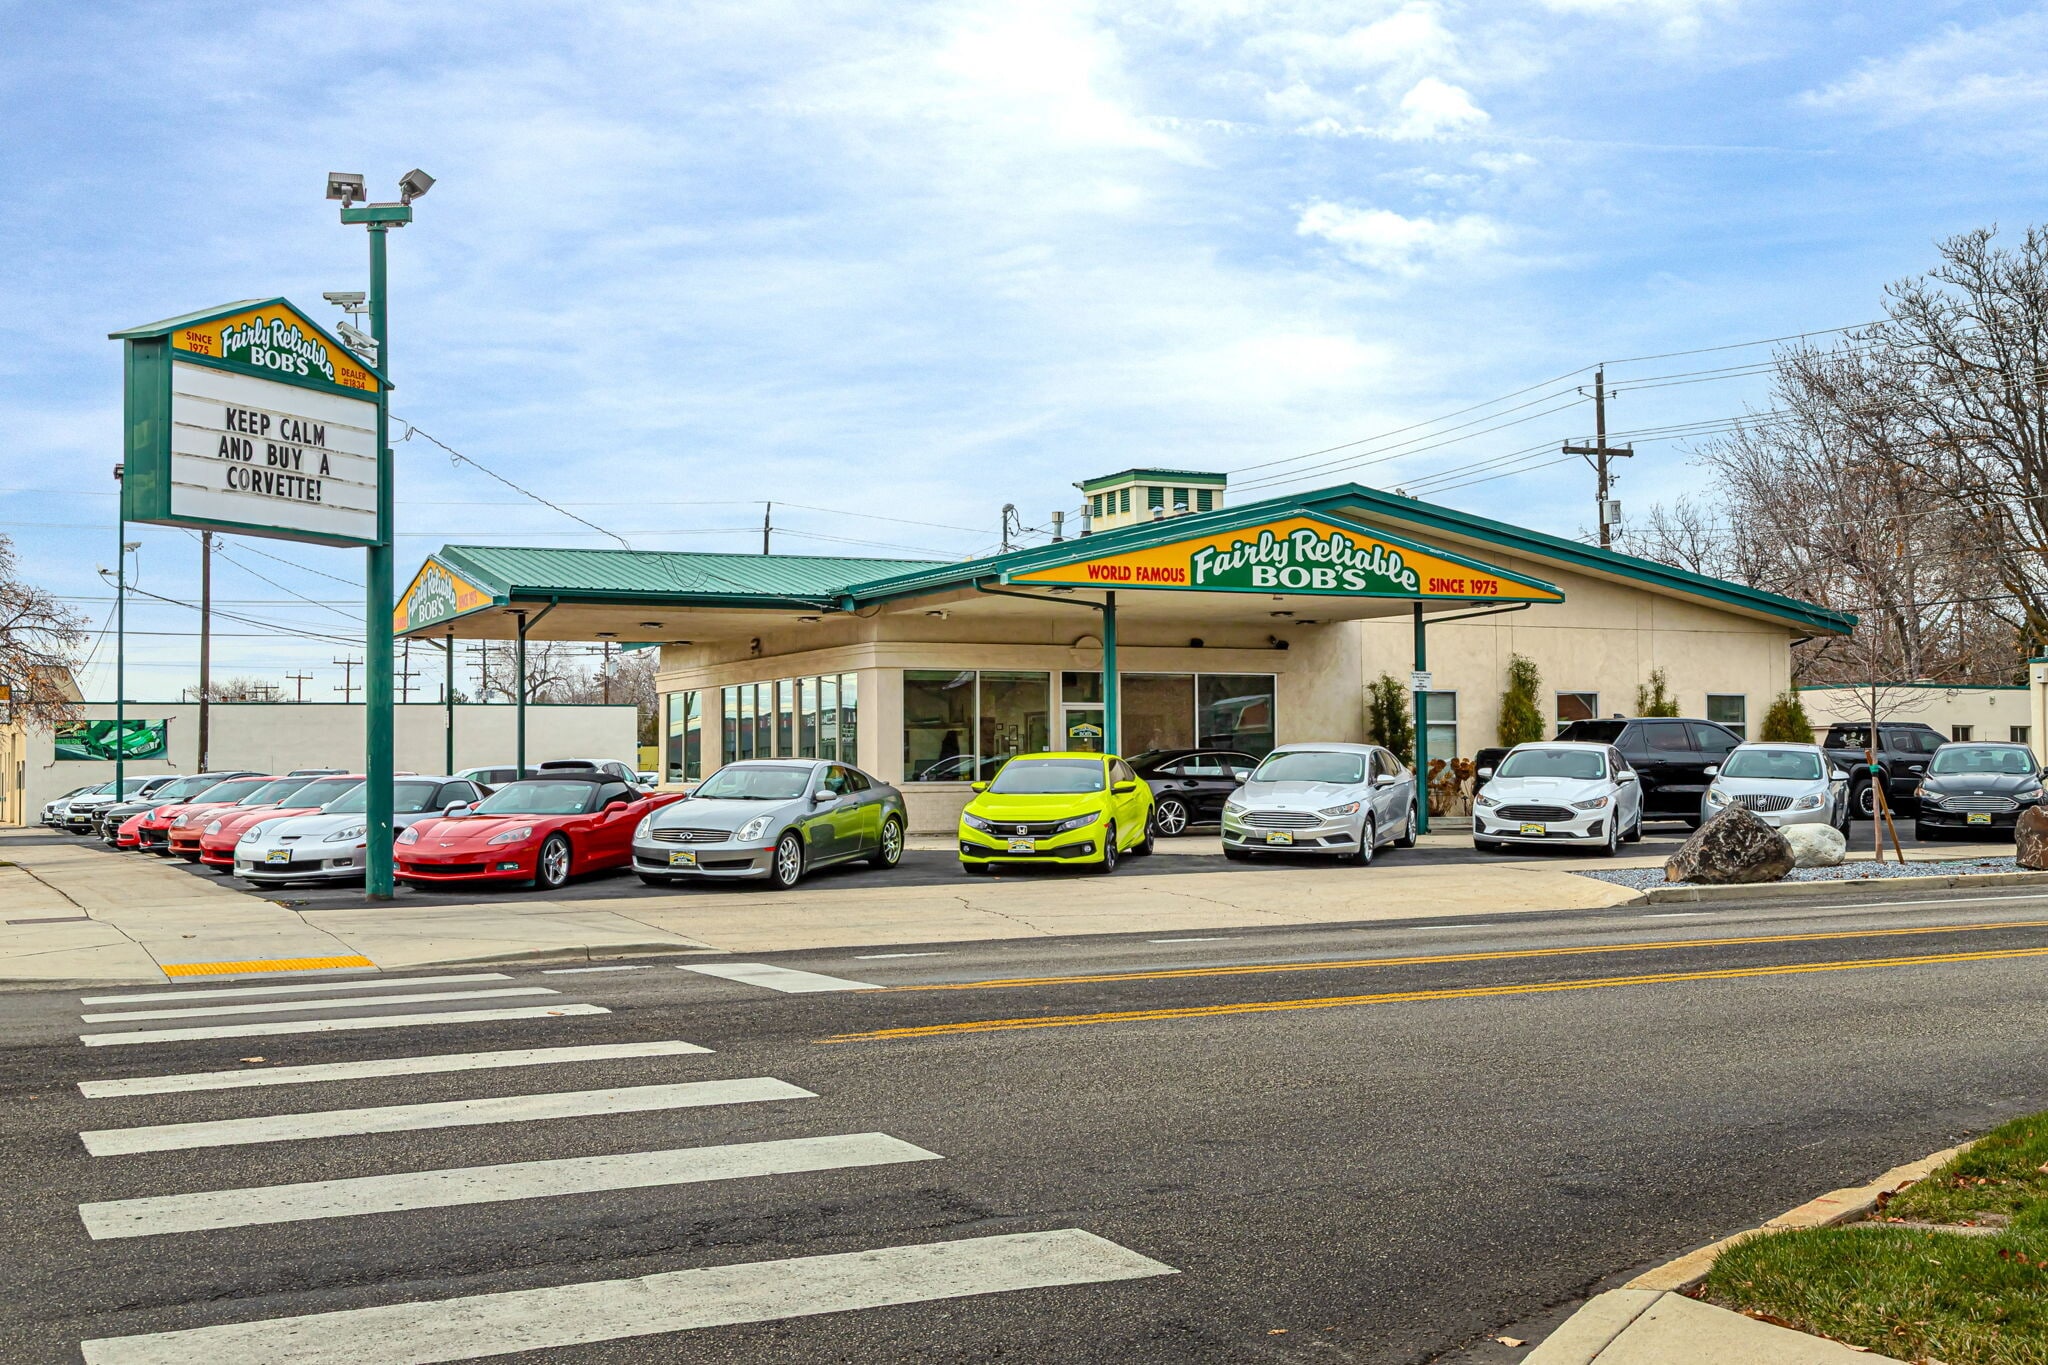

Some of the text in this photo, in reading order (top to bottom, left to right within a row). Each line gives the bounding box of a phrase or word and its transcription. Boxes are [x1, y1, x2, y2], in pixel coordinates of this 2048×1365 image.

[186, 331, 212, 345] SINCE
[189, 342, 209, 355] 1975
[222, 318, 334, 381] Fairly Reliable
[251, 346, 309, 376] BOB'S
[341, 368, 366, 381] DEALER
[343, 378, 365, 390] #1834
[226, 407, 325, 447] KEEP CALM
[218, 435, 330, 475] AND BUY A
[227, 466, 321, 501] CORVETTE!
[1088, 564, 1185, 582] WORLD FAMOUS
[1193, 530, 1418, 591] Fairly Reliable
[1252, 565, 1366, 590] BOB'S
[1429, 577, 1498, 595] SINCE 1975
[418, 596, 444, 623] BOB'S
